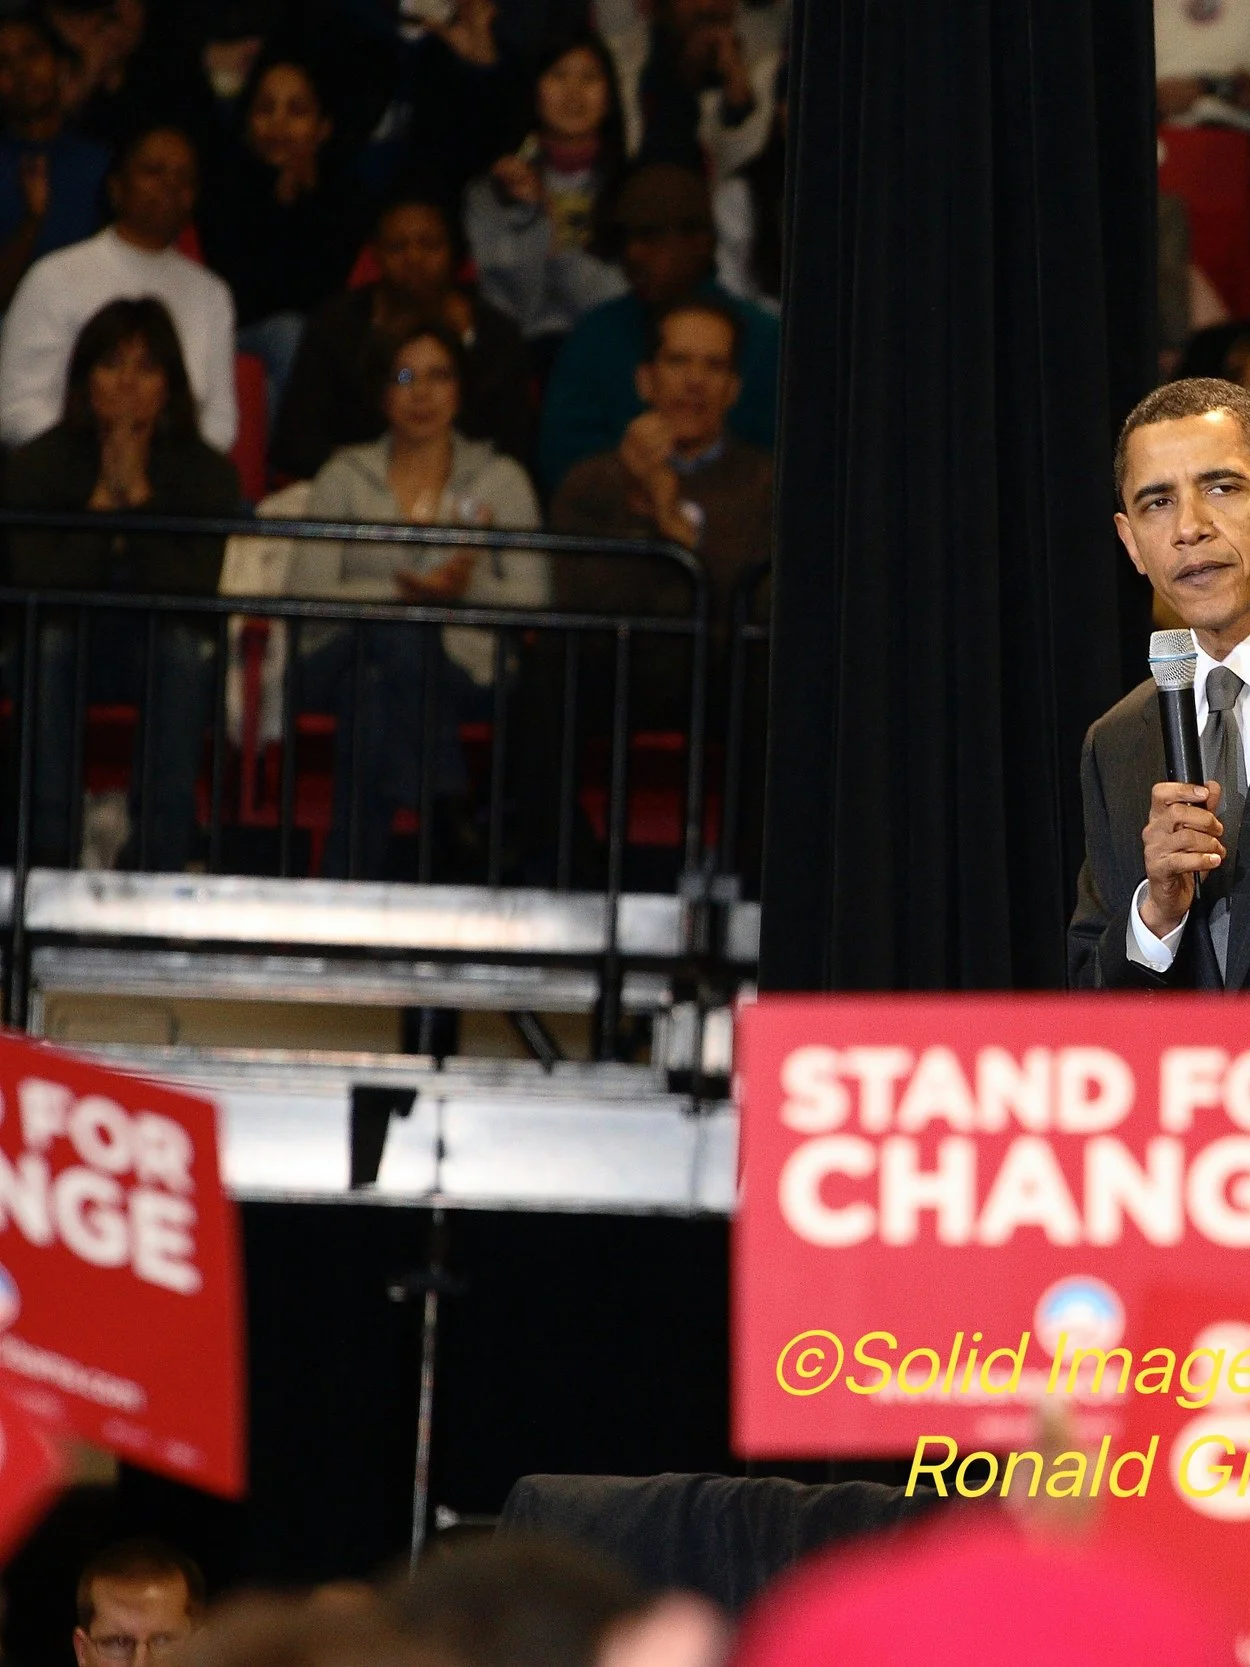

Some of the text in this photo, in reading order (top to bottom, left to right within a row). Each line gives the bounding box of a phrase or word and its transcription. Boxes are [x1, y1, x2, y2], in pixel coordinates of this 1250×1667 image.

[17, 1075, 196, 1196] FOR
[780, 1045, 1135, 1135] STAND
[0, 1150, 204, 1297] NGE
